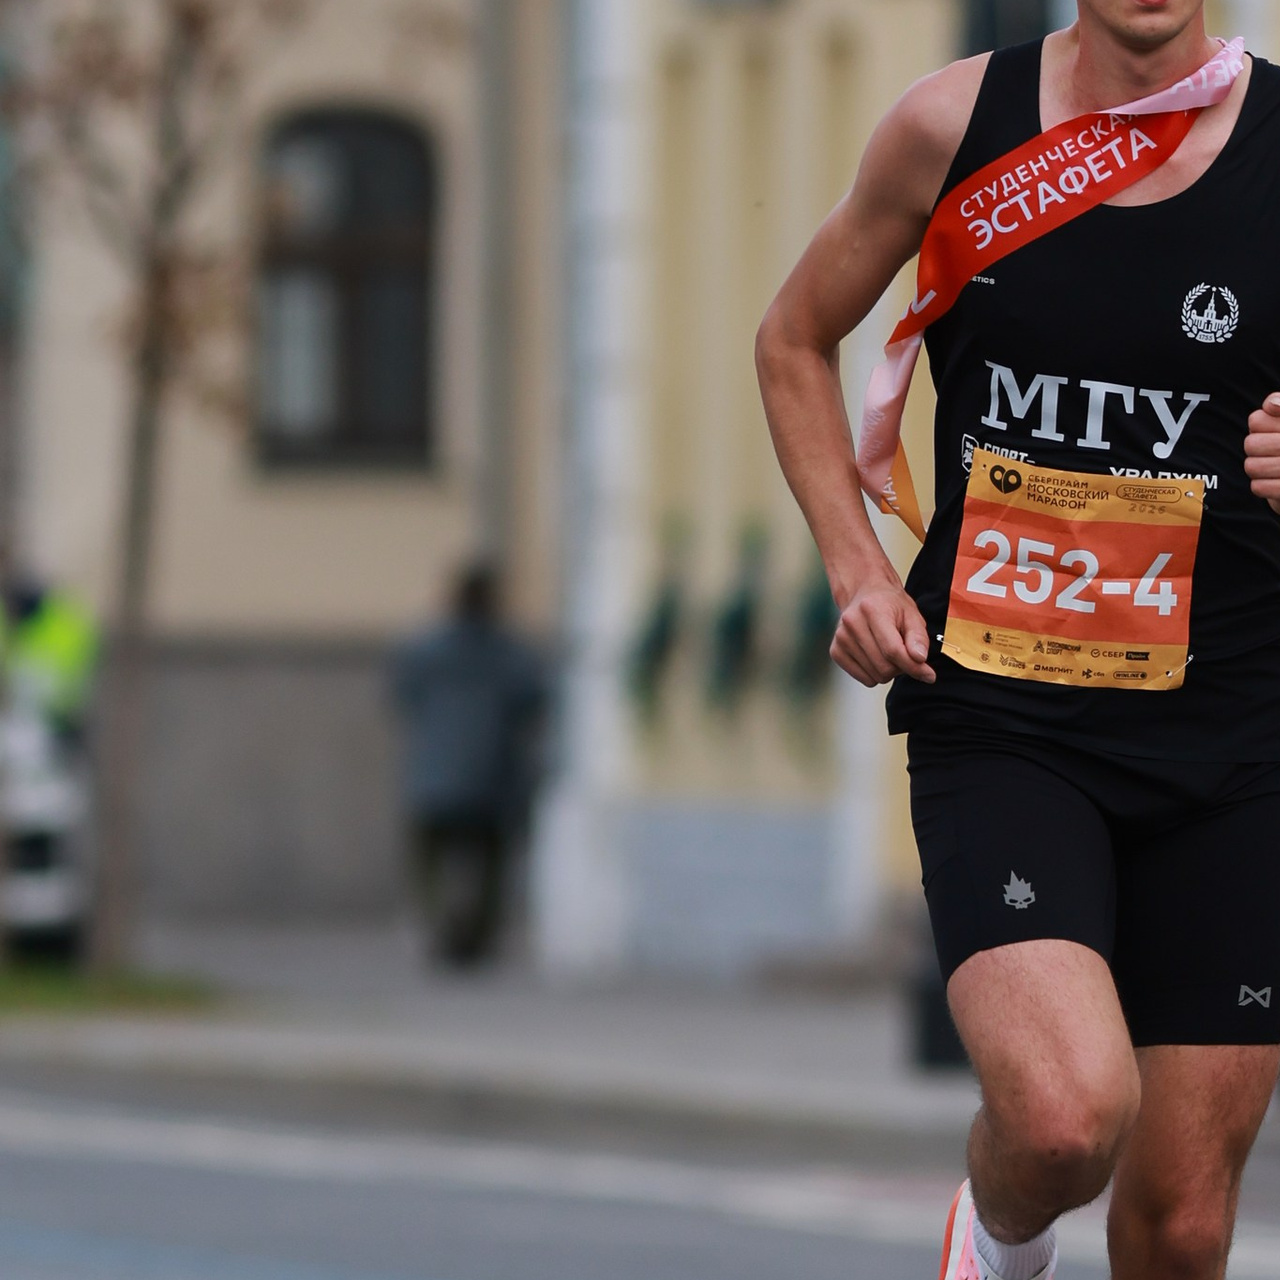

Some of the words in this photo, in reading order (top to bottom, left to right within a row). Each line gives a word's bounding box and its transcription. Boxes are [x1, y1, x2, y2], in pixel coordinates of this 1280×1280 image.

[967, 127, 1158, 251] ЭСТАФЕТА
[970, 275, 995, 285] ETICS
[980, 359, 1211, 460] МГУ
[1028, 474, 1089, 489] СБЕРПРАЙМ
[1027, 482, 1109, 501] МОСКОВСКИЙ
[1122, 492, 1158, 500] ЭСТАФЕТА
[1123, 486, 1176, 495] СТУДЕНЧЕСКАЯ
[1027, 492, 1087, 510] МАРАФОН
[966, 528, 1178, 616] 252-4
[1102, 650, 1125, 658] СБЕР
